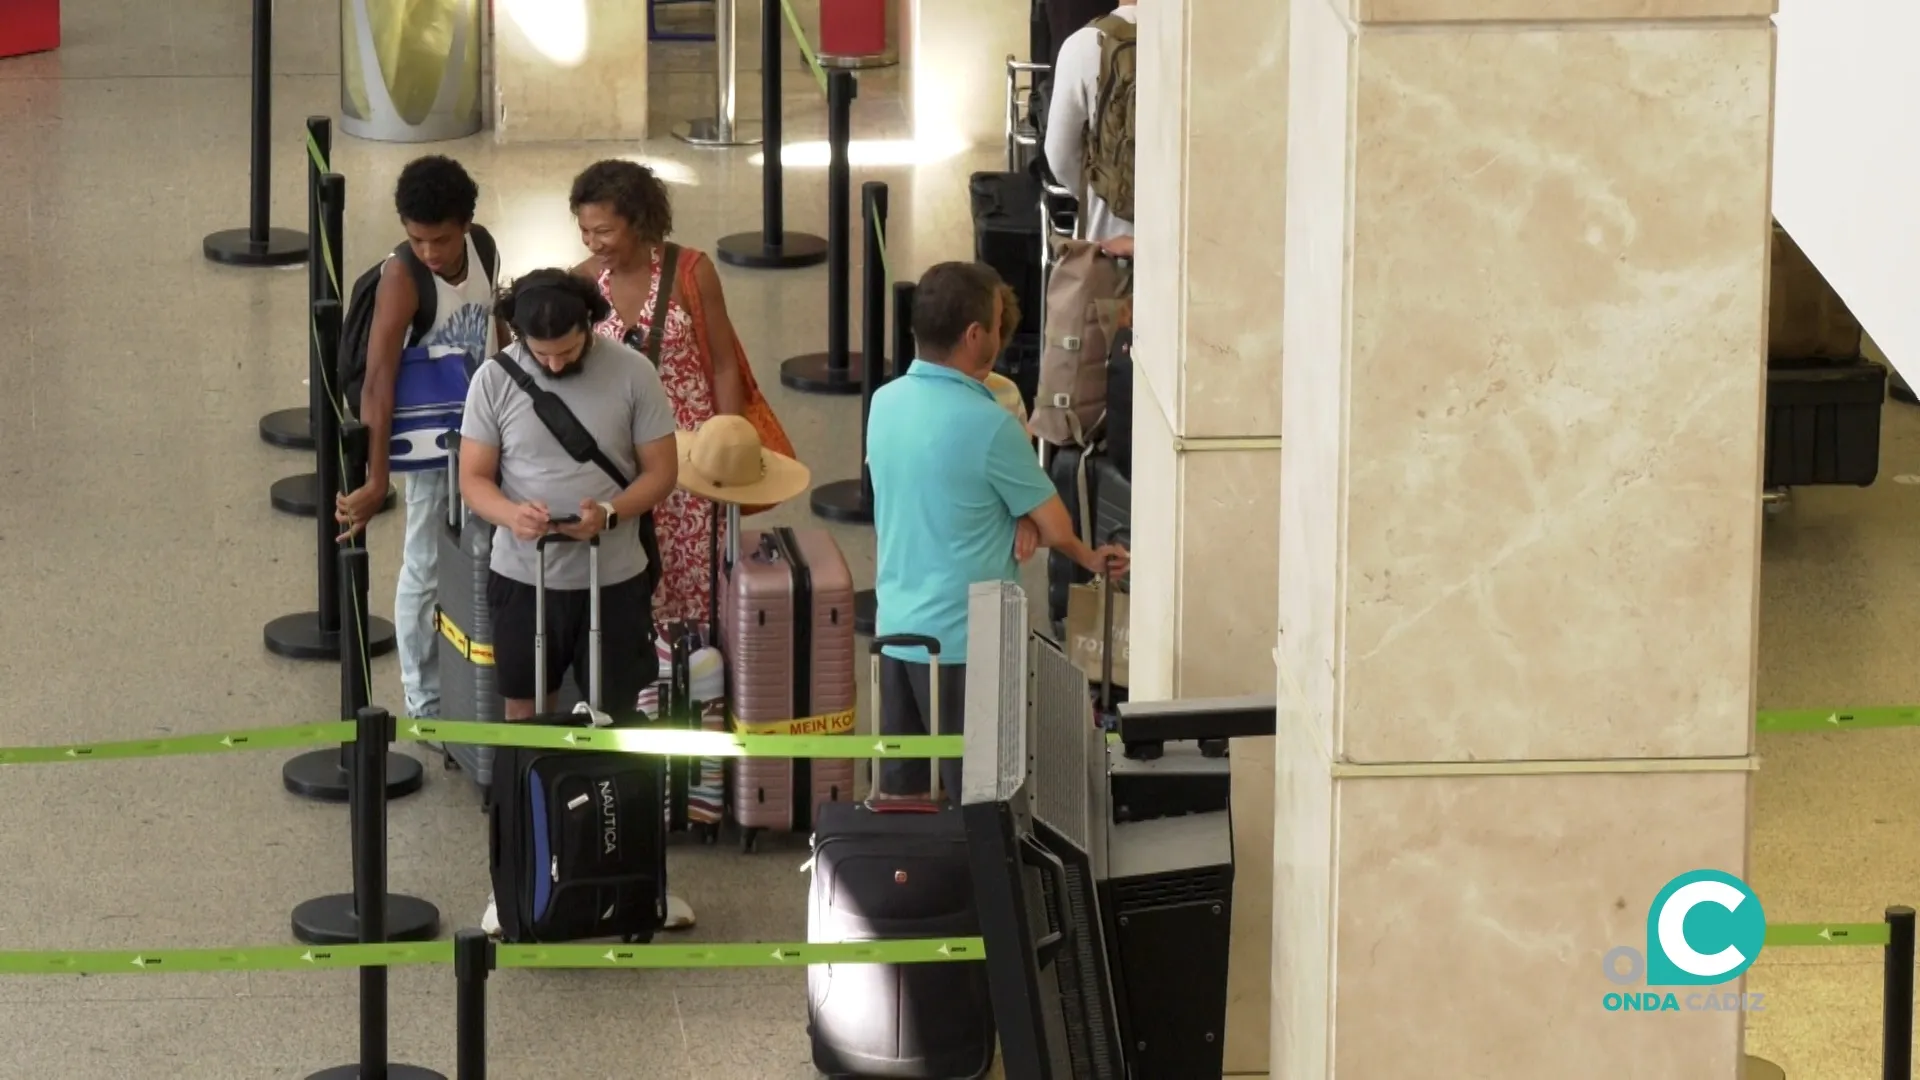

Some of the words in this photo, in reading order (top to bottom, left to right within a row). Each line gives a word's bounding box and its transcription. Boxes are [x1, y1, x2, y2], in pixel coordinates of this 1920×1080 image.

[789, 715, 827, 736] MEIN
[831, 710, 855, 729] KO
[598, 781, 617, 855] NAUTICA
